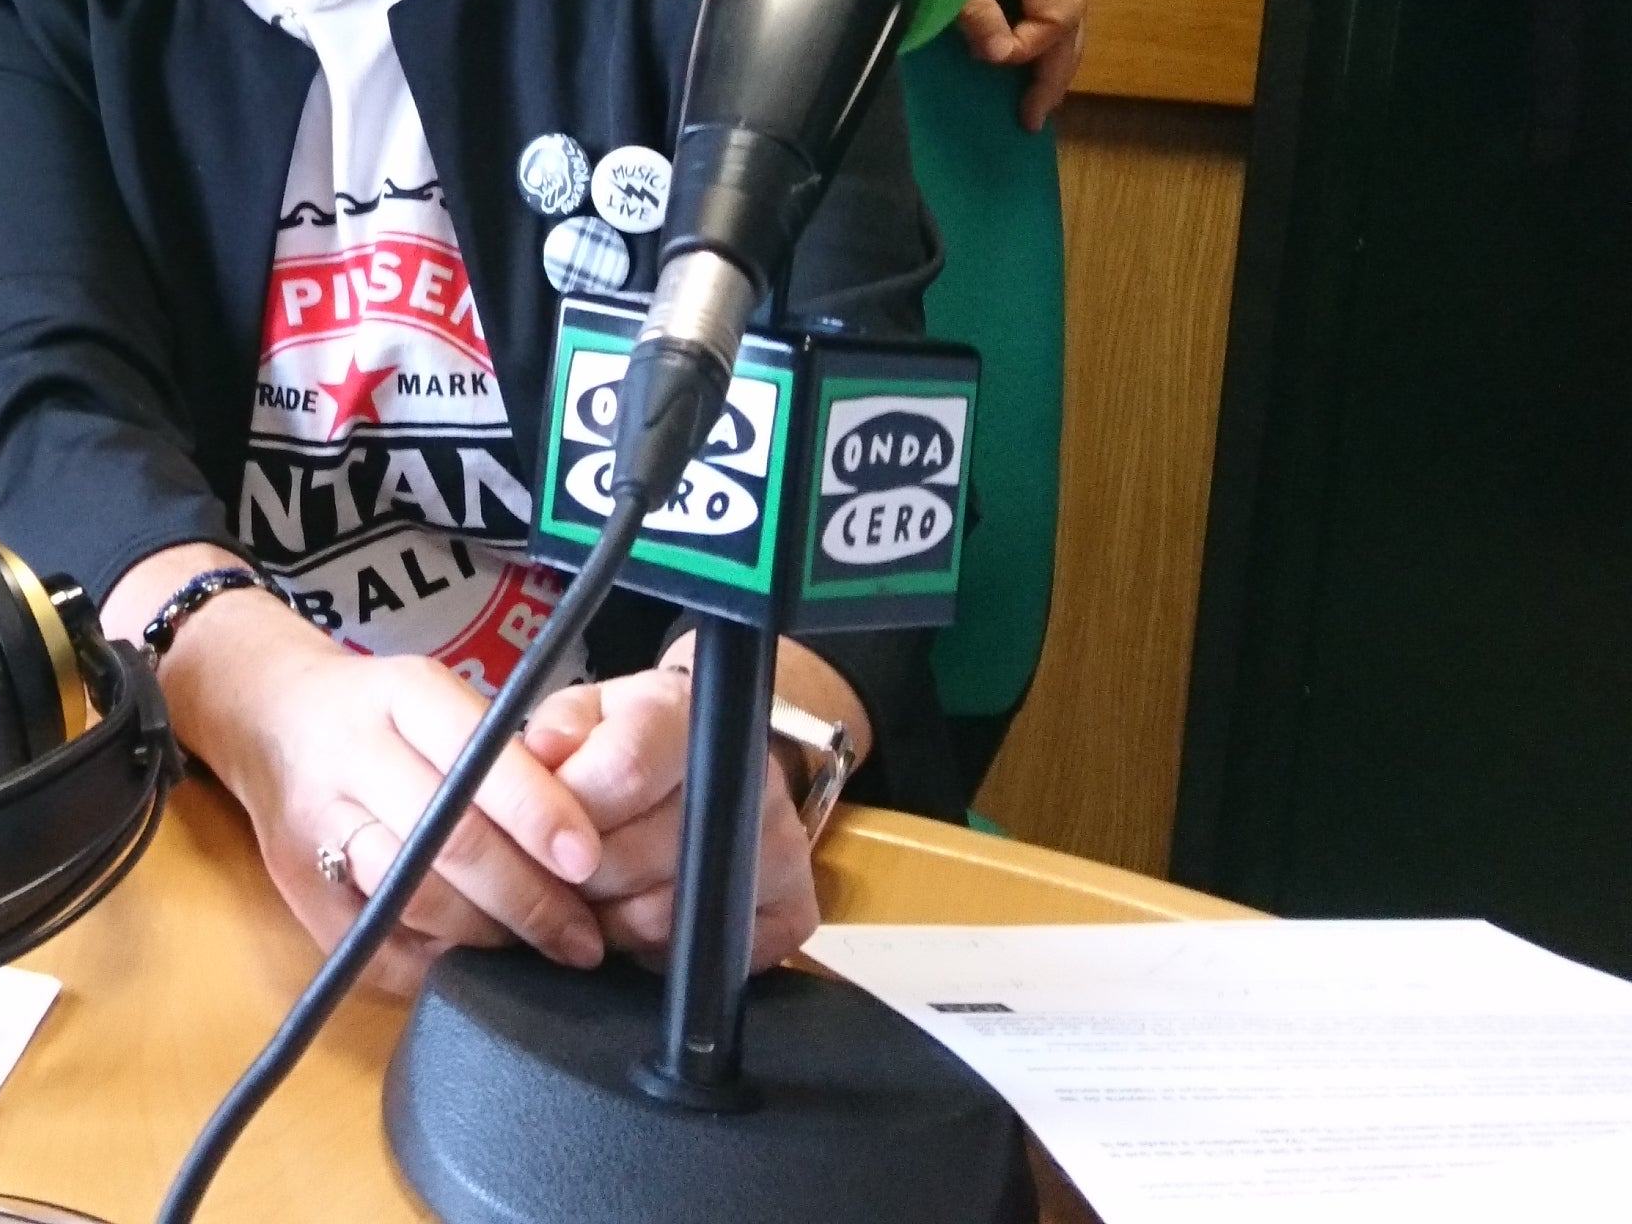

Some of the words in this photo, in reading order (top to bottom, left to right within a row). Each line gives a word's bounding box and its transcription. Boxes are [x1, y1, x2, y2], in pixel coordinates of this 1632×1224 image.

[397, 373, 488, 397] MARK
[591, 387, 738, 450] OA
[843, 433, 943, 473] ONDA
[594, 462, 730, 521] CRO
[843, 506, 937, 546] CERO
